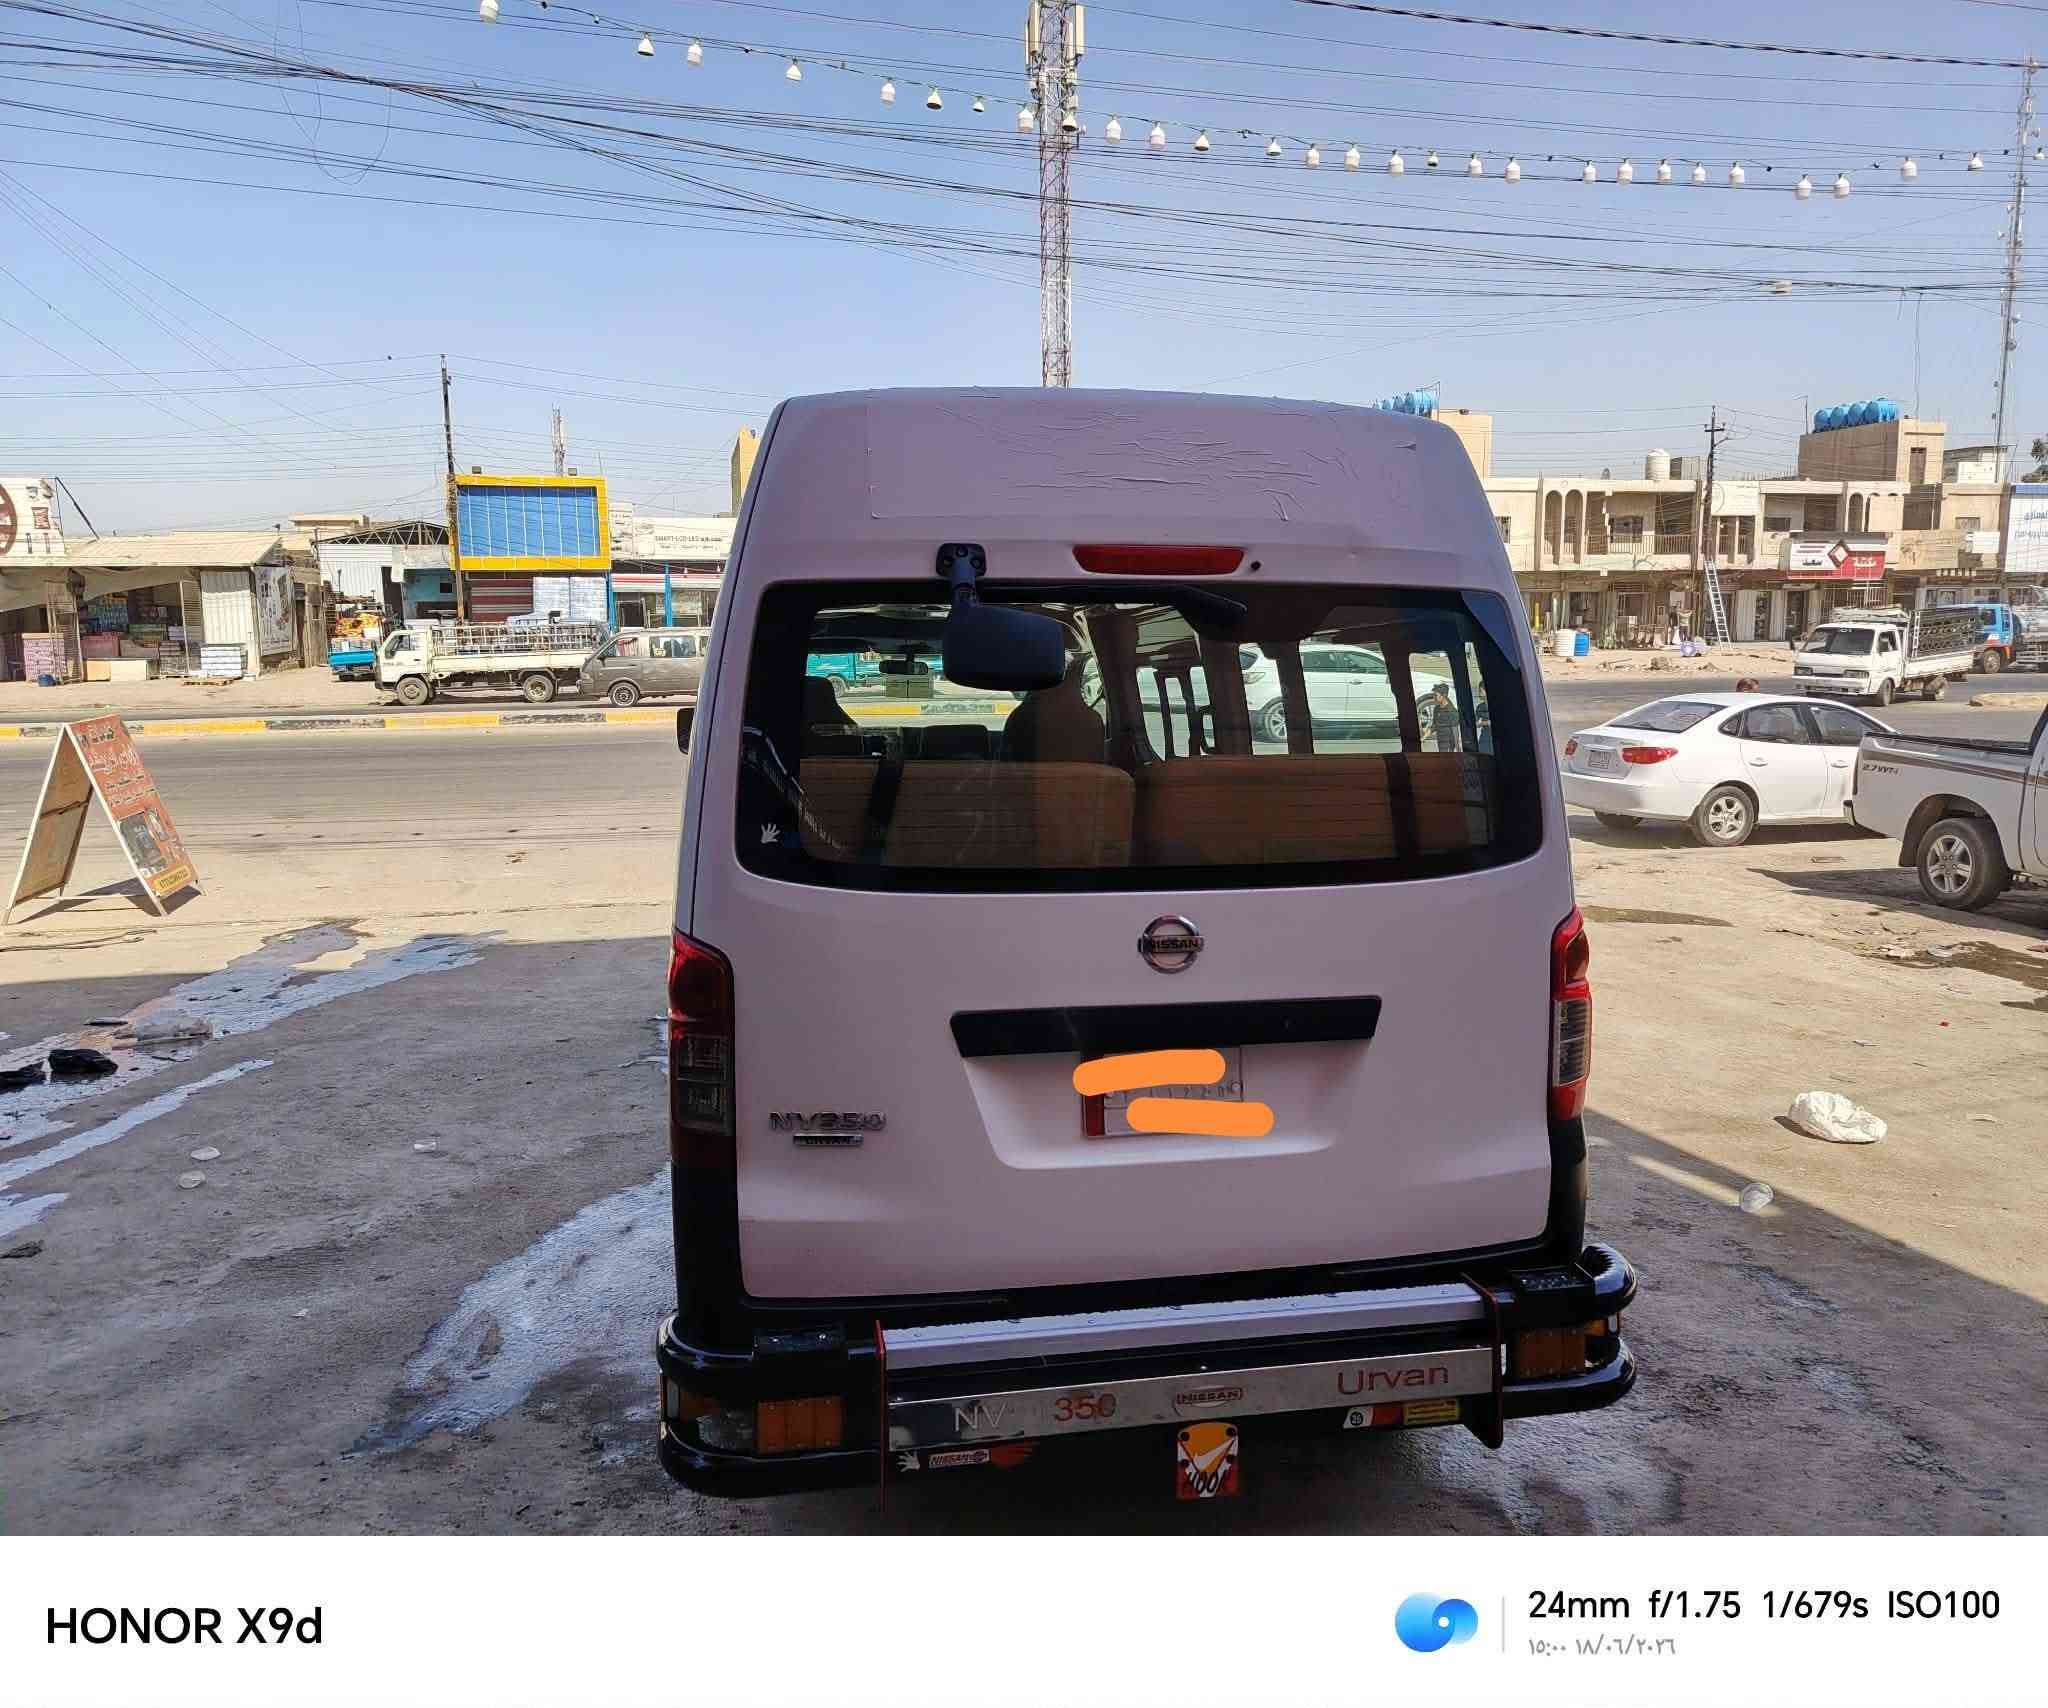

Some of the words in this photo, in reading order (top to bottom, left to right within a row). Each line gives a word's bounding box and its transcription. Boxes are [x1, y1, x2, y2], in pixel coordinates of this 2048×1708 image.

[769, 1112, 887, 1130] NV350
[1337, 1366, 1449, 1395] Urvan
[1182, 1390, 1238, 1403] NISSAN
[954, 1401, 1009, 1432] NV
[1054, 1393, 1117, 1422] 350
